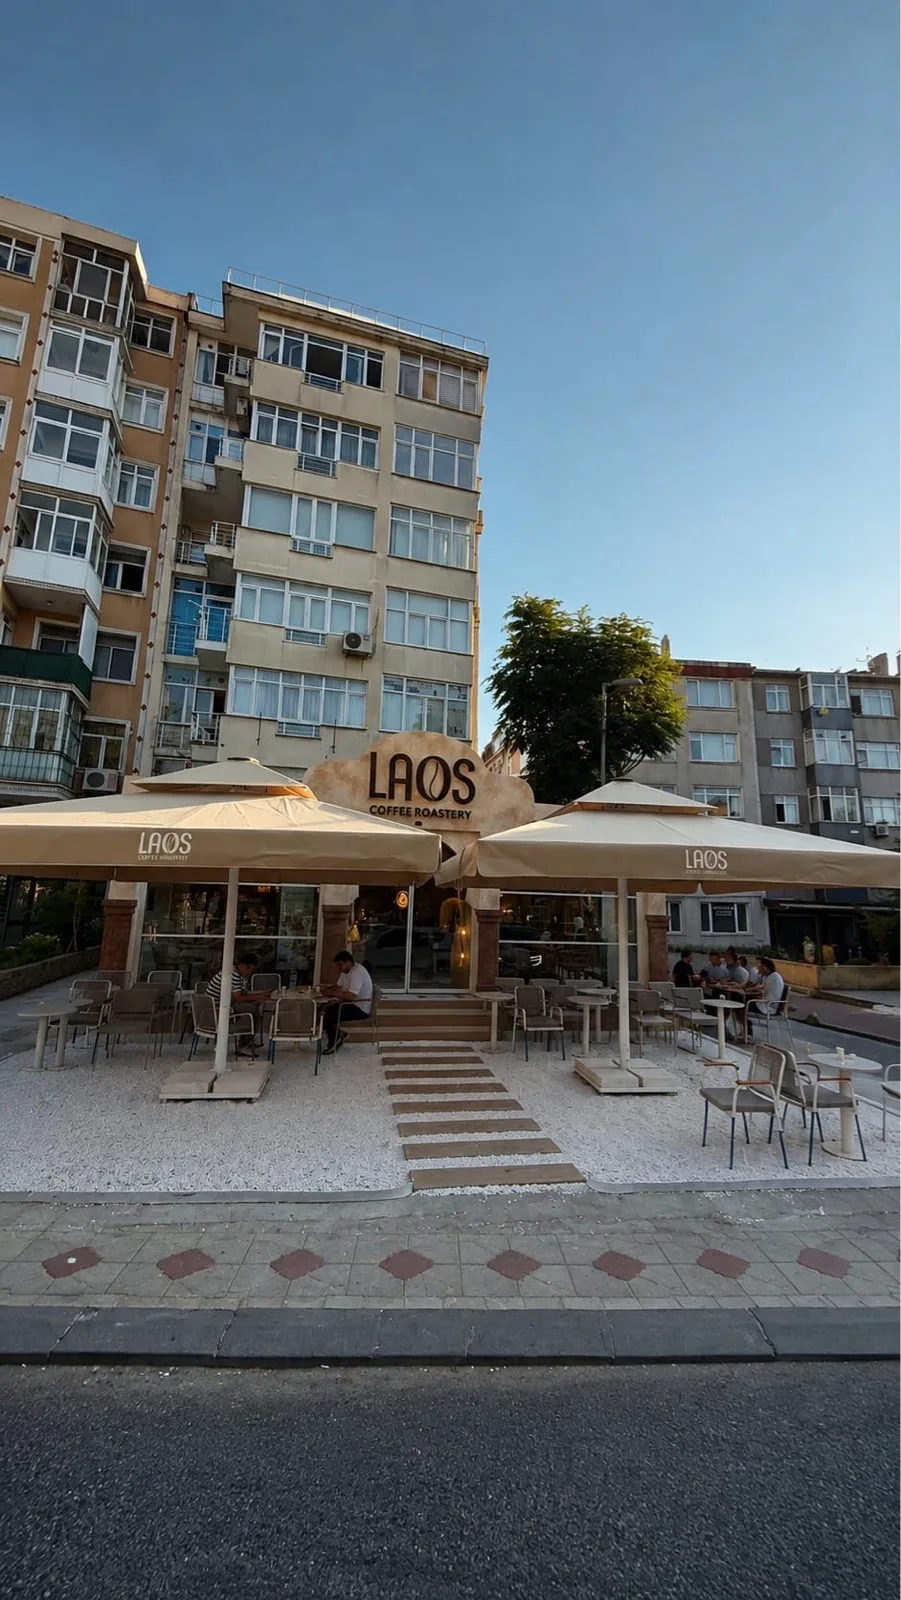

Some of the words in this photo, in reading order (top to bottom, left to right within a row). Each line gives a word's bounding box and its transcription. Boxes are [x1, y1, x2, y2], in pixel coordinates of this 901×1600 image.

[369, 751, 476, 805] LAOS
[369, 805, 412, 817] COFFEE
[414, 807, 472, 819] ROASTERY
[138, 832, 193, 854] LAOS
[685, 849, 727, 869] LAOS
